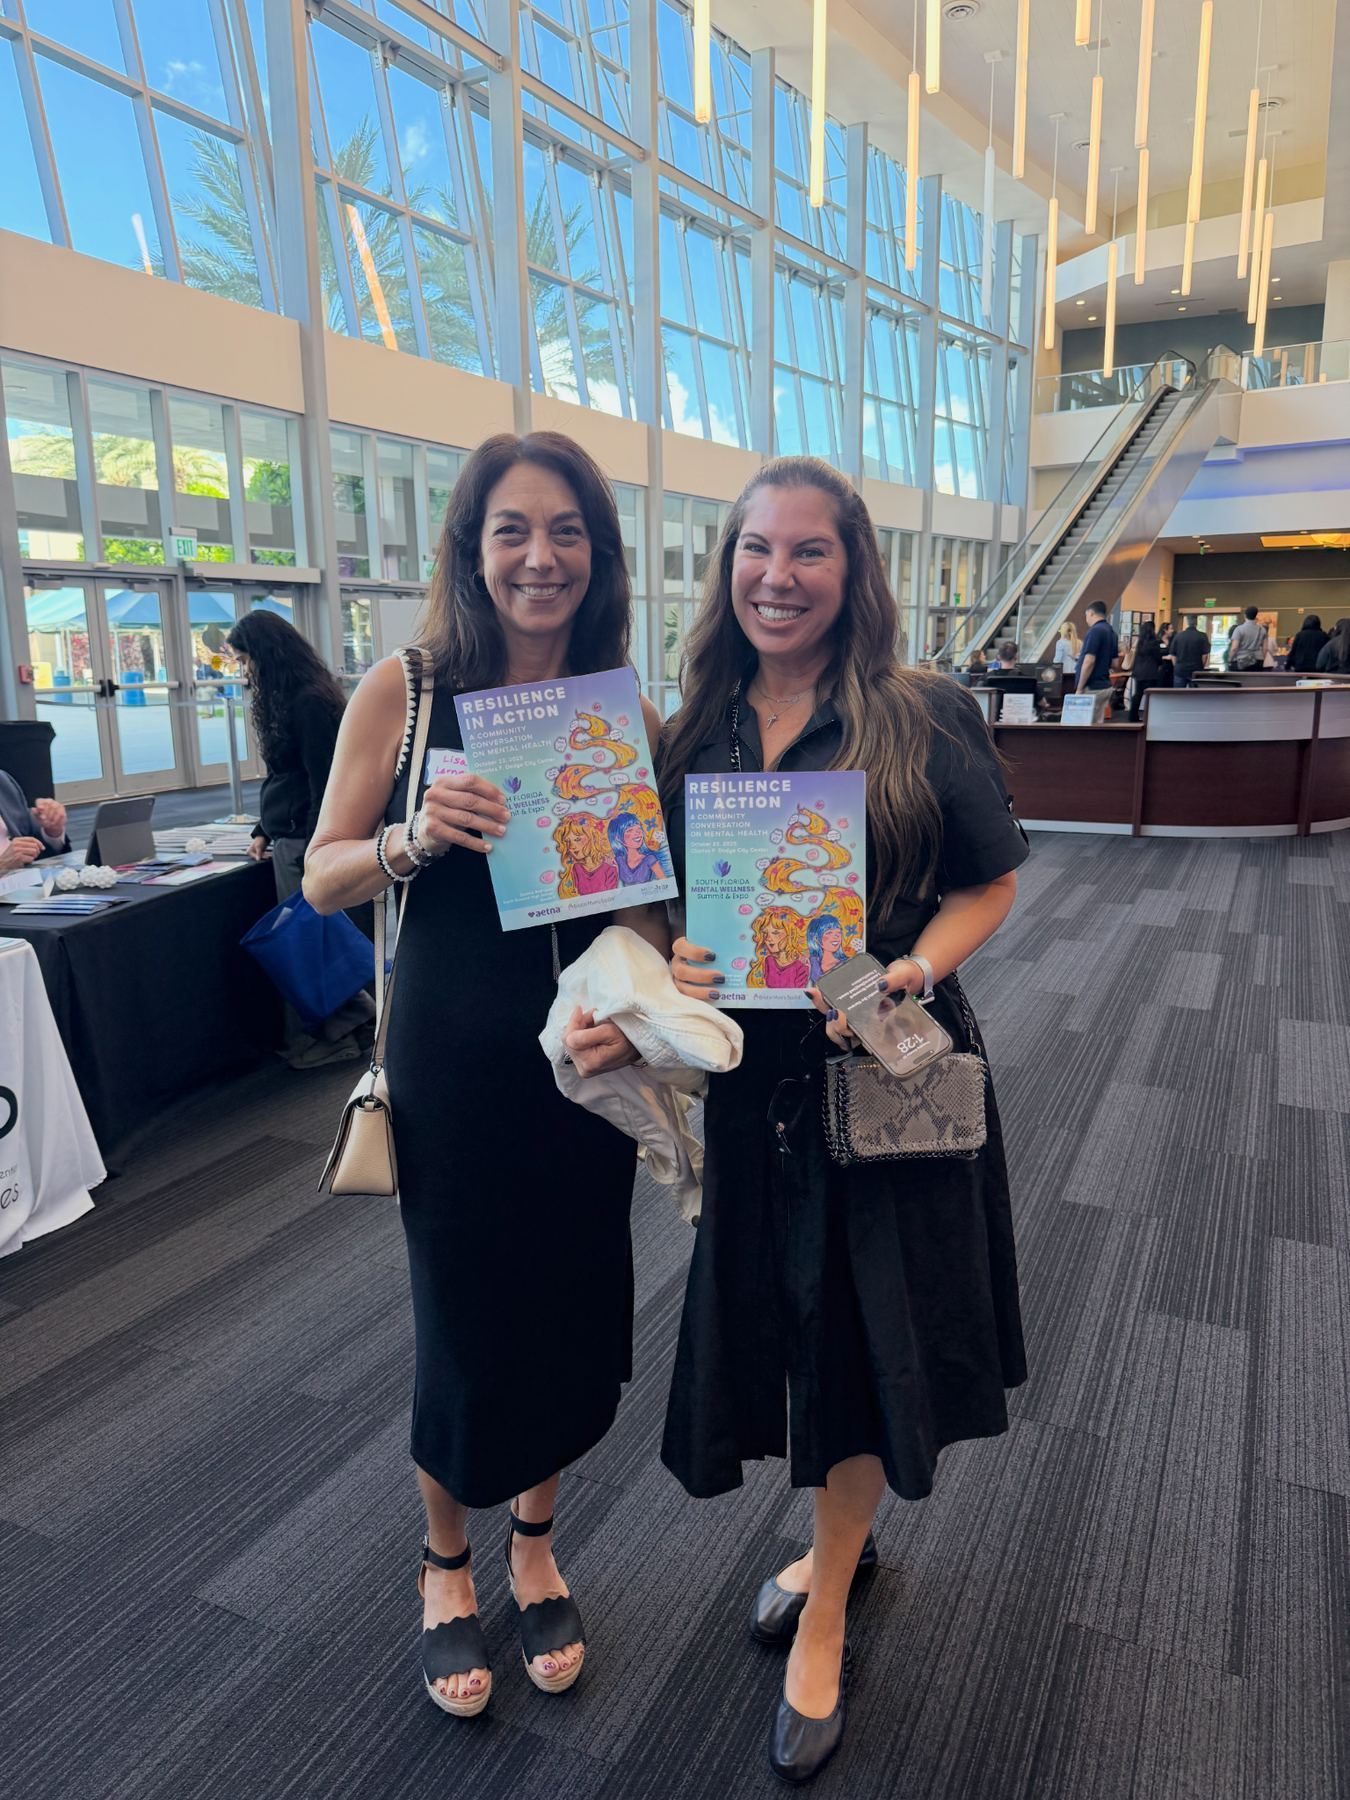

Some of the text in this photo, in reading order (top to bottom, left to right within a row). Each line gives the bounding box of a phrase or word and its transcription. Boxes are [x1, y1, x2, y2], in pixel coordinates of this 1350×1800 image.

[176, 539, 193, 557] EXIT
[462, 687, 566, 715] RESILIENCE
[465, 715, 484, 731] IN
[492, 704, 559, 727] ACTION
[477, 725, 527, 740] COMMUNITY
[470, 733, 534, 750] CONVERSATION
[472, 750, 485, 759] ON
[487, 744, 519, 756] MENTAL
[521, 738, 552, 750] HEALTH
[442, 755, 467, 767] Lisa
[689, 779, 791, 794] RESILIENCE
[513, 791, 544, 802] FLORIDA
[513, 797, 549, 809] WELLNESS
[690, 796, 781, 810] IN ACTION
[528, 806, 545, 815] Expo
[697, 812, 745, 820] COMMUNITY
[690, 821, 751, 829] CONVERSATION
[737, 829, 769, 837] HEALTH
[732, 892, 749, 901] Expo
[535, 906, 561, 918] aetna
[720, 992, 746, 1001] aetna
[896, 1033, 924, 1053] 1:28
